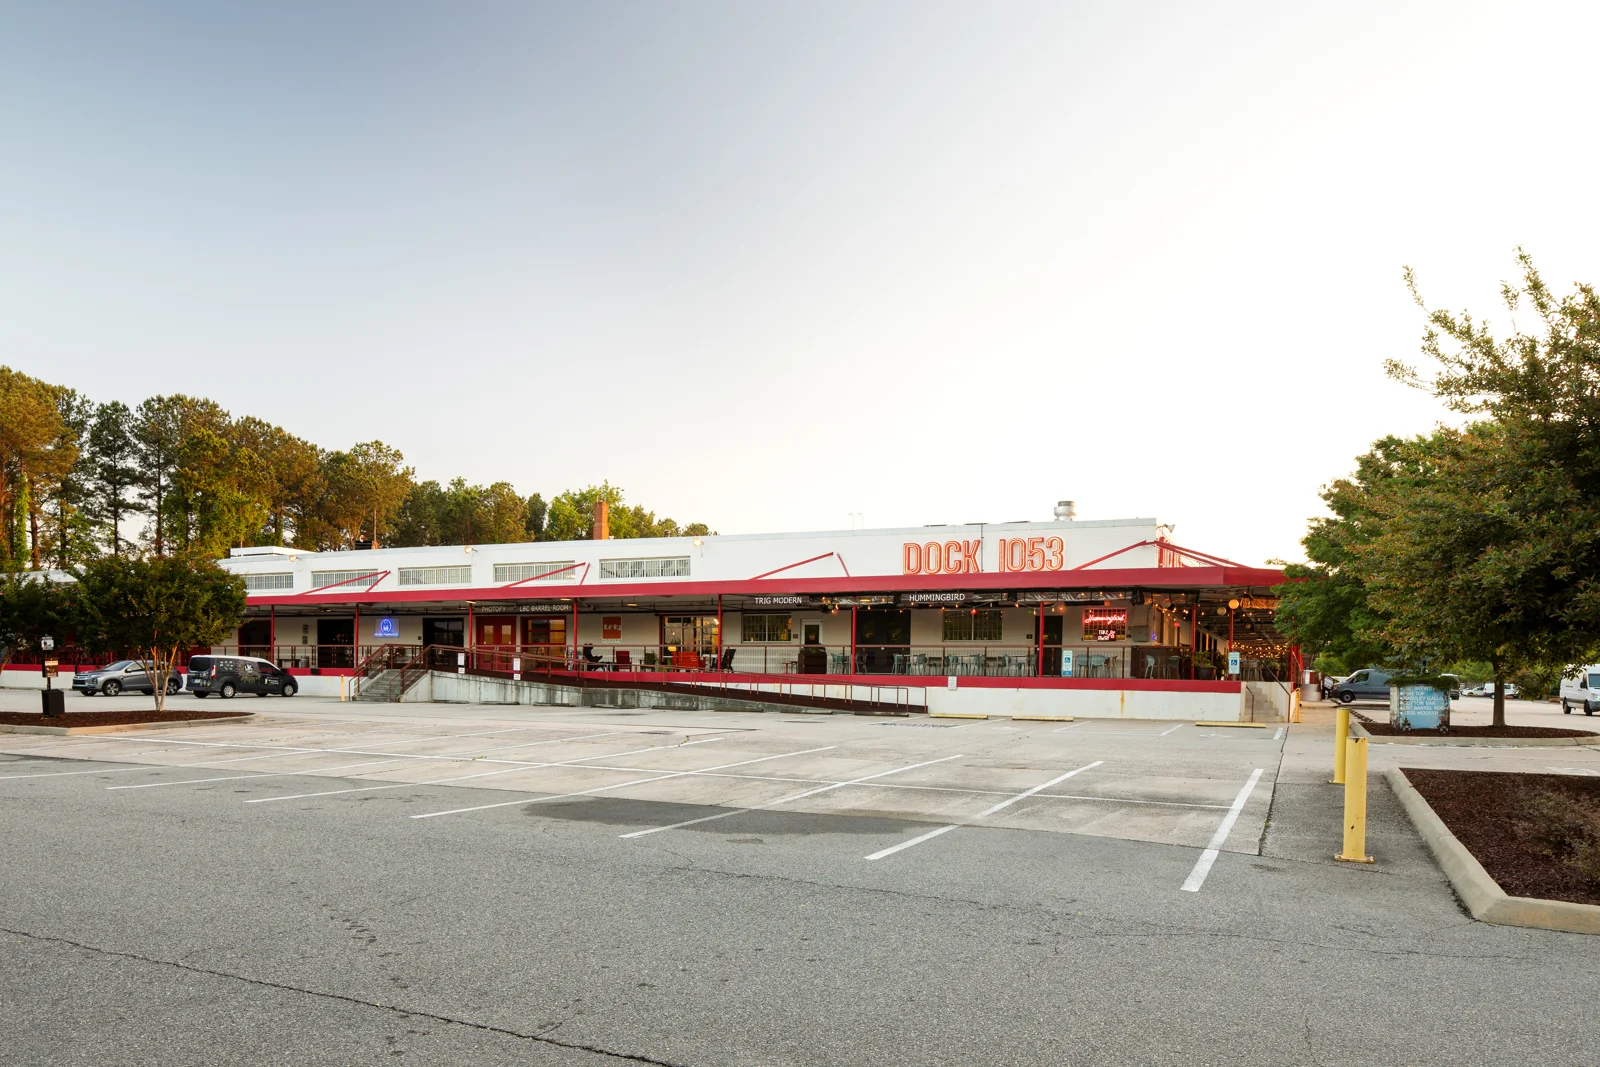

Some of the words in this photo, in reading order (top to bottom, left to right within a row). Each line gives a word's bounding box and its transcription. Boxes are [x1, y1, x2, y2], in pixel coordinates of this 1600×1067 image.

[903, 540, 981, 574] DOCK
[999, 536, 1064, 572] 1053
[755, 597, 772, 605] TRIG
[773, 596, 803, 604] MODERN
[909, 593, 966, 602] HUMMINGBIRD
[530, 604, 551, 612] BARREL
